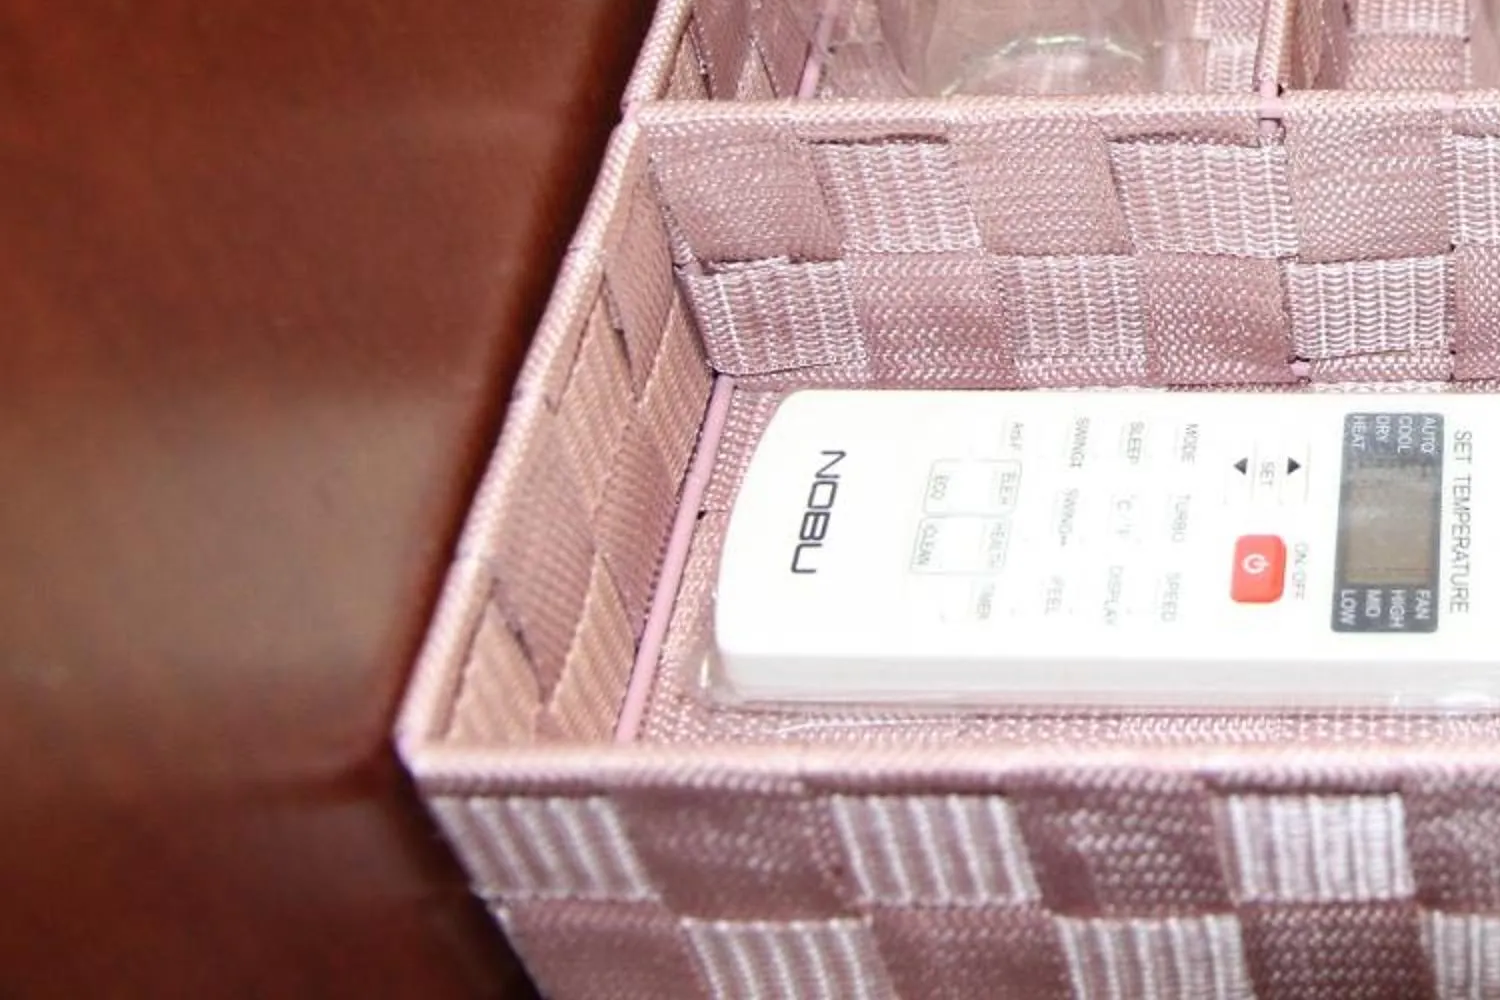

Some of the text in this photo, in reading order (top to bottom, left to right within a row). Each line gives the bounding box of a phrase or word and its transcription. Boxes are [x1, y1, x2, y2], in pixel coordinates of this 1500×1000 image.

[1126, 420, 1145, 465] SLEEP
[1180, 423, 1199, 464] MODE
[1351, 415, 1366, 451] HEAT
[1375, 415, 1390, 442] DRY
[1398, 415, 1412, 453] COOL
[1421, 417, 1435, 454] AUTO
[1259, 460, 1276, 488] SET
[790, 450, 847, 575] NOBU
[1449, 429, 1473, 615] SET TEMPERATURE
[1160, 572, 1182, 623] SPEED
[1341, 590, 1355, 625] LOW
[1365, 590, 1380, 618] MID
[1390, 589, 1404, 628] HIGH
[1416, 590, 1430, 619] FAN
